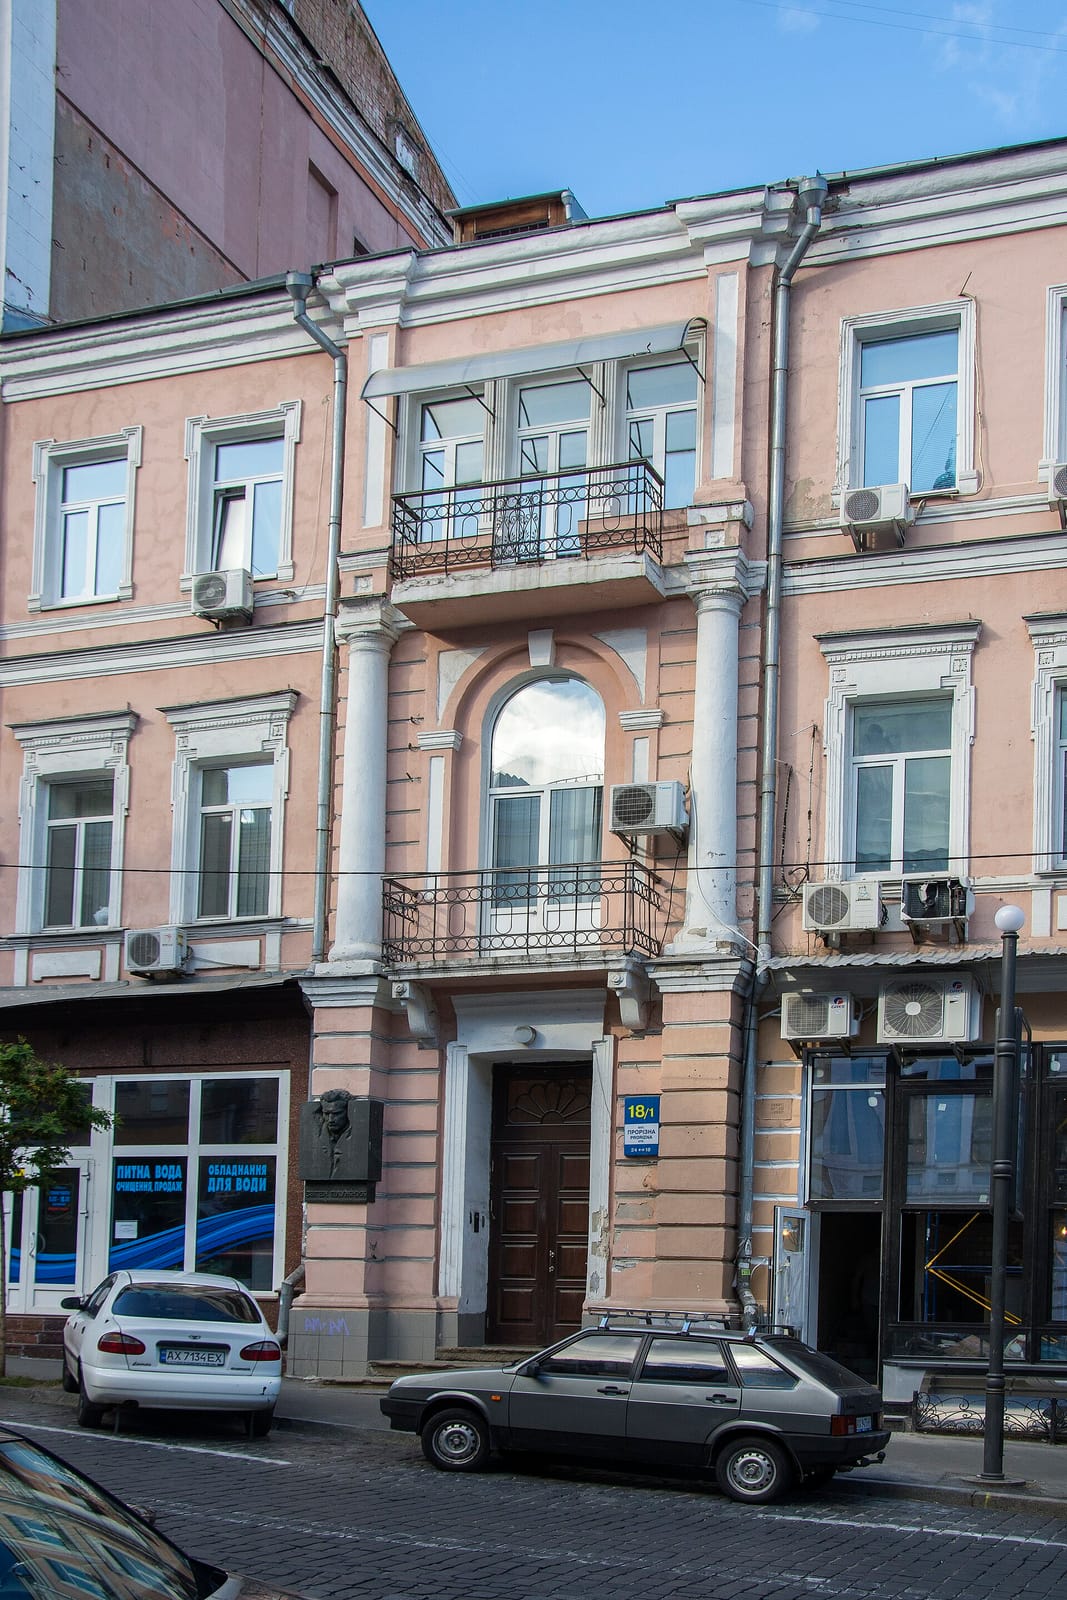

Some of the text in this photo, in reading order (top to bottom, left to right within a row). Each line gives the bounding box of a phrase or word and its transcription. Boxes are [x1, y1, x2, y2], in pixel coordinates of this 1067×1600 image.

[628, 1104, 654, 1120] 18/1
[117, 1165, 182, 1180] ПИТНА ВОДА
[208, 1164, 267, 1176] ОБЛАДНАННЯ
[154, 1181, 183, 1192] ПРОДАЖ
[207, 1178, 267, 1193] ДЛЯ ВОДИ
